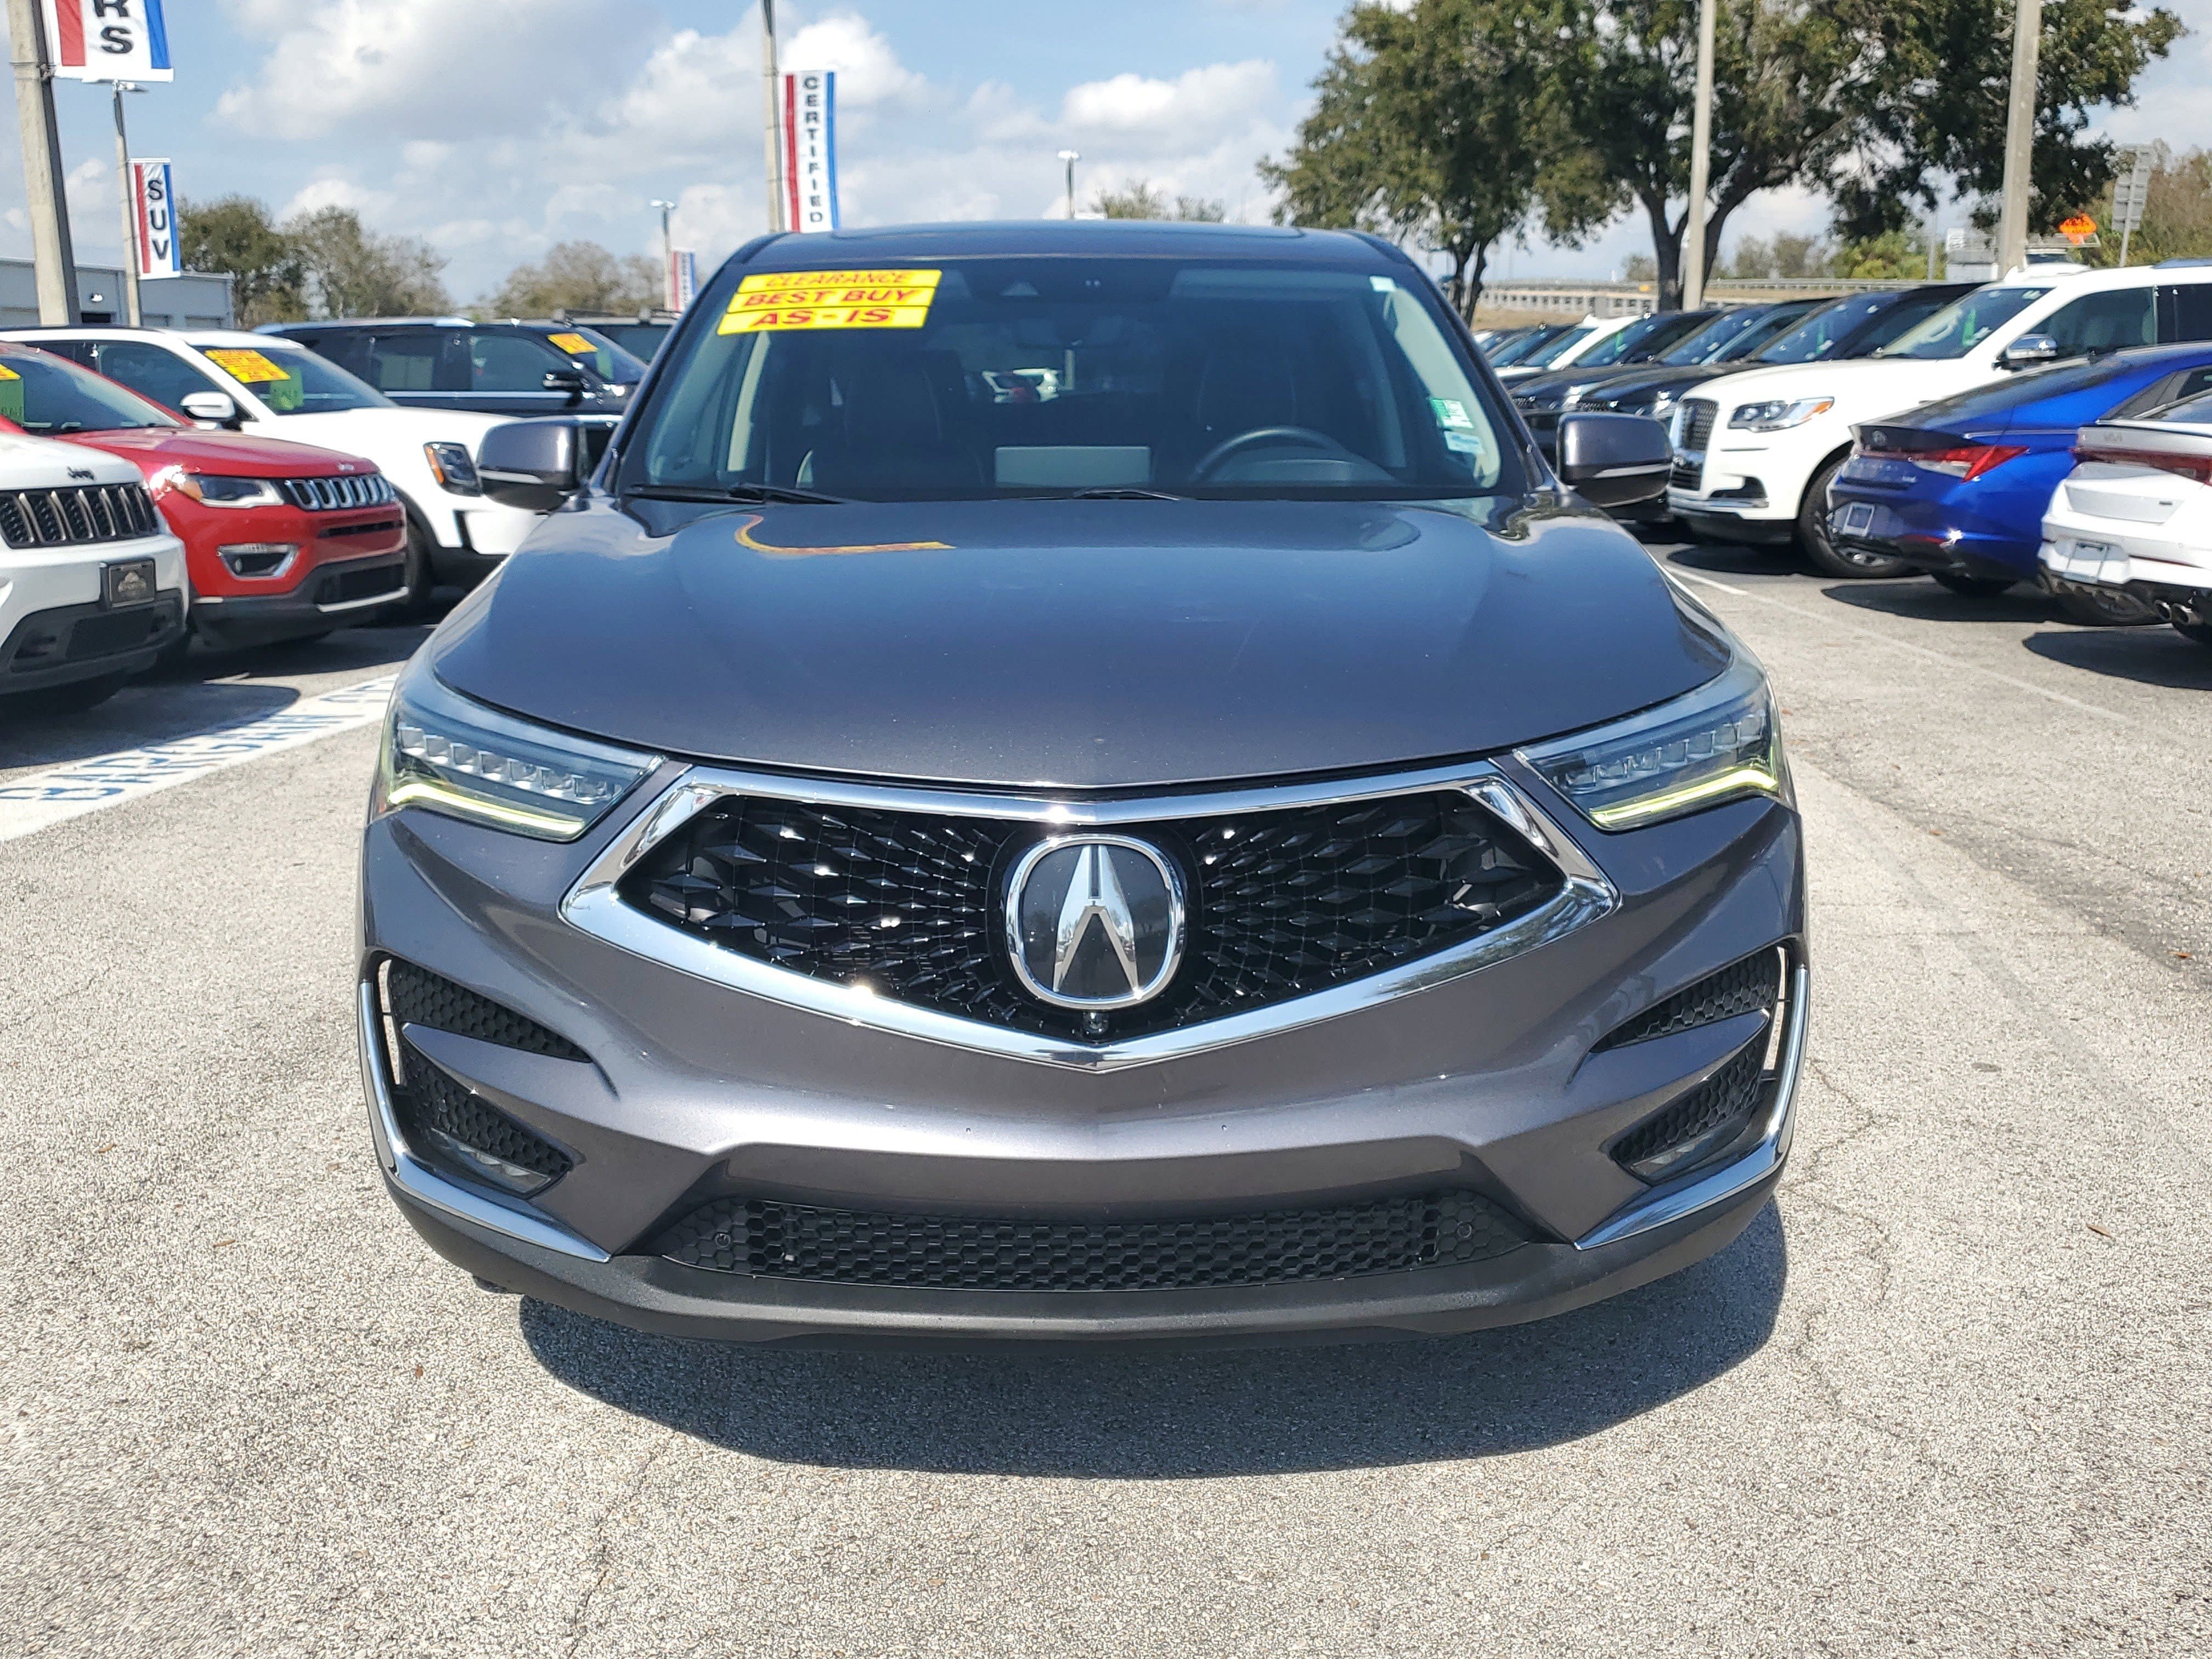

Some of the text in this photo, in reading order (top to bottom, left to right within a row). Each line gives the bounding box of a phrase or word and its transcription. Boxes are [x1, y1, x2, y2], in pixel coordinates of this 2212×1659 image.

[803, 76, 823, 223] CERTIFIED
[148, 179, 170, 260] SUV
[743, 289, 919, 306] BEST BUY
[766, 272, 911, 287] CLEARANCE
